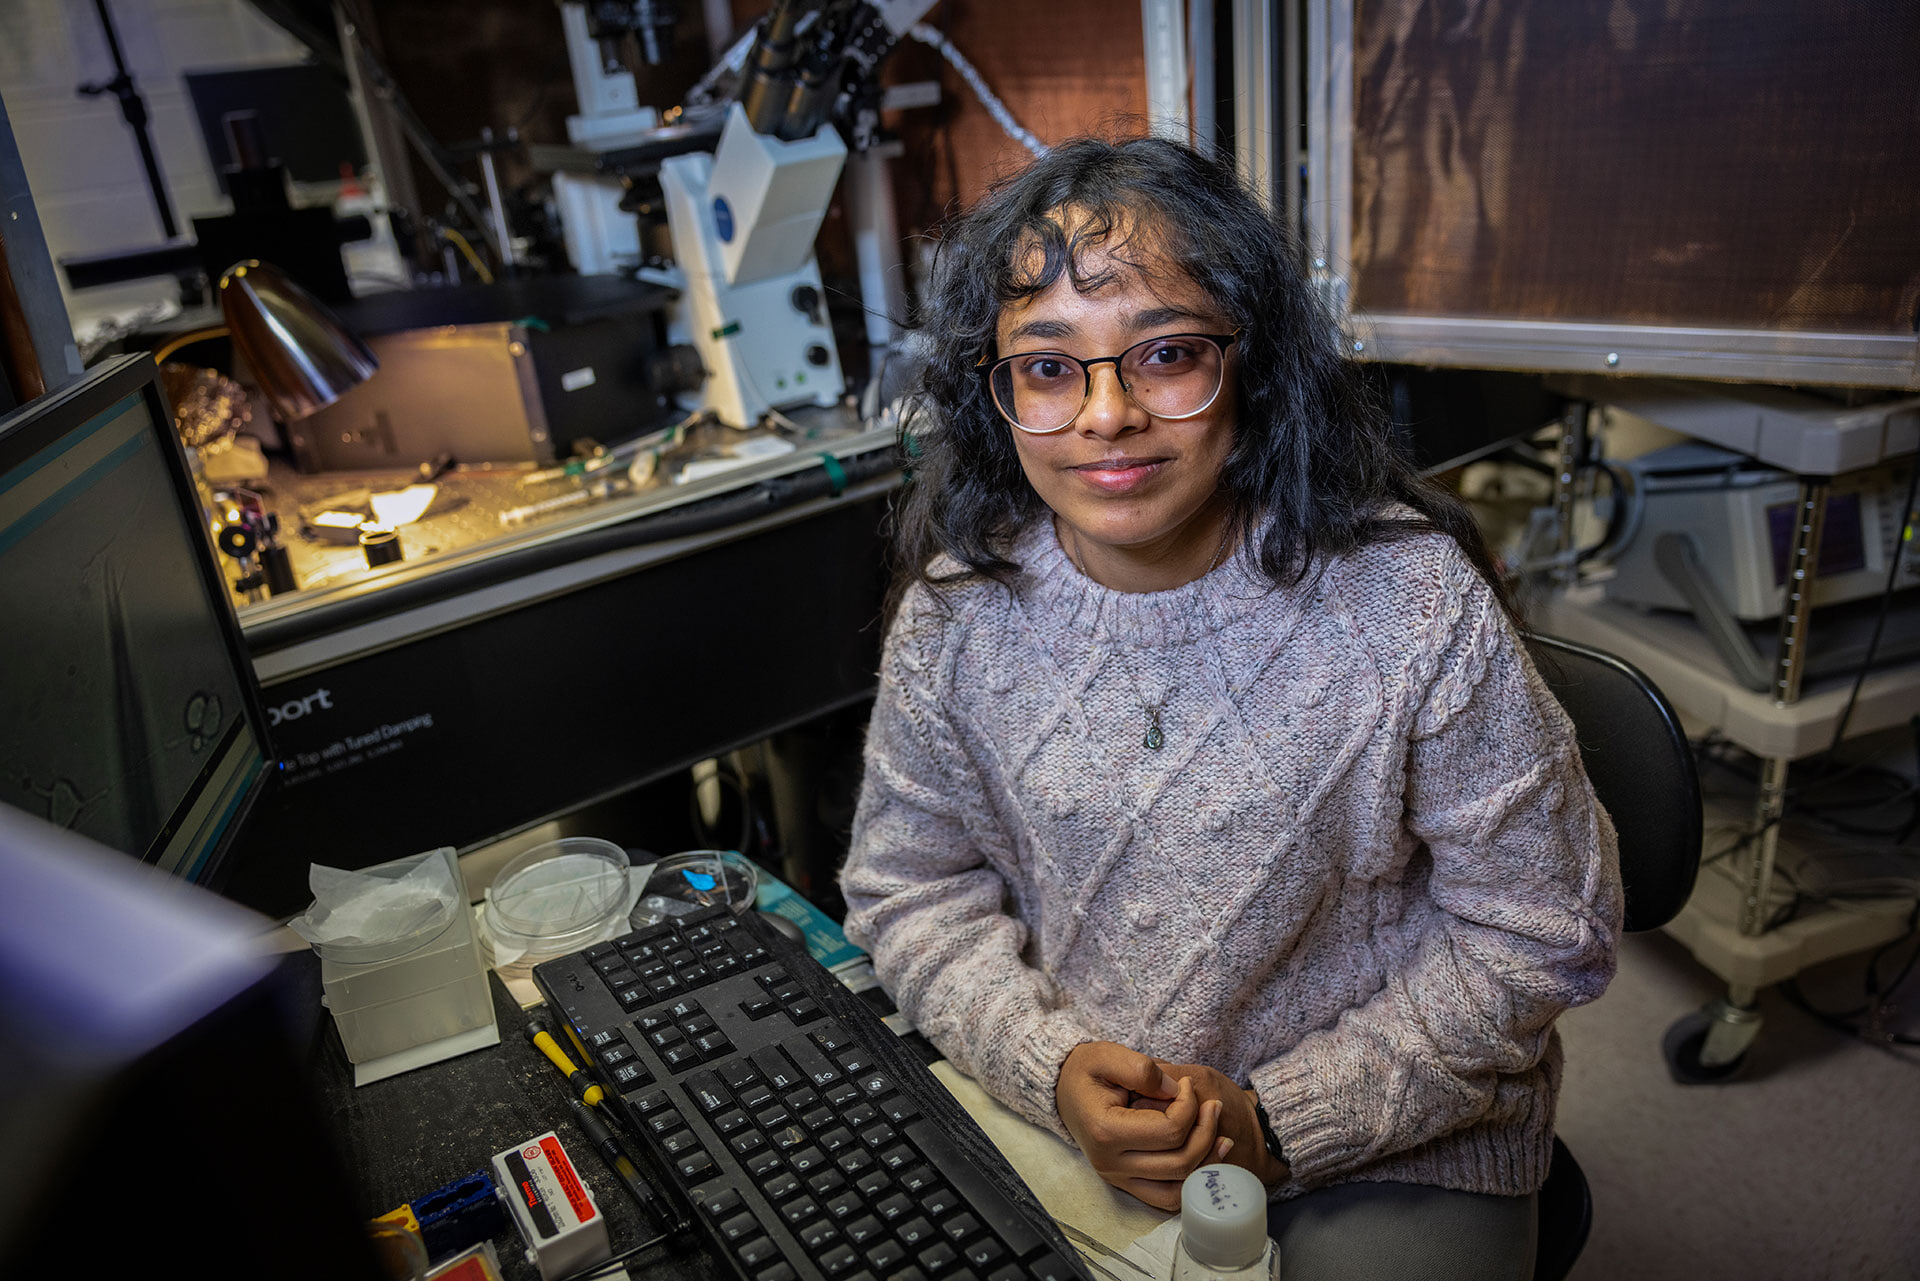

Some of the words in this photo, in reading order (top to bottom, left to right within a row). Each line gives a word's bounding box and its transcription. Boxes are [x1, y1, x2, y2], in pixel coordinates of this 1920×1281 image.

[321, 742, 346, 759] with
[346, 728, 381, 750] Tuned
[380, 713, 433, 740] Damping
[640, 1100, 650, 1111] F12
[654, 1121, 664, 1132] F11
[889, 1156, 902, 1165] M
[847, 1162, 859, 1170] K
[910, 1179, 922, 1188] N
[522, 1181, 538, 1208] Thermo
[836, 1206, 847, 1215] U
[887, 1208, 899, 1216] H
[932, 1204, 943, 1212] B
[855, 1231, 866, 1239] Y
[907, 1232, 918, 1241] G
[952, 1228, 964, 1237] V
[877, 1257, 888, 1266] T
[976, 1253, 987, 1262] C
[929, 1260, 942, 1269] F
